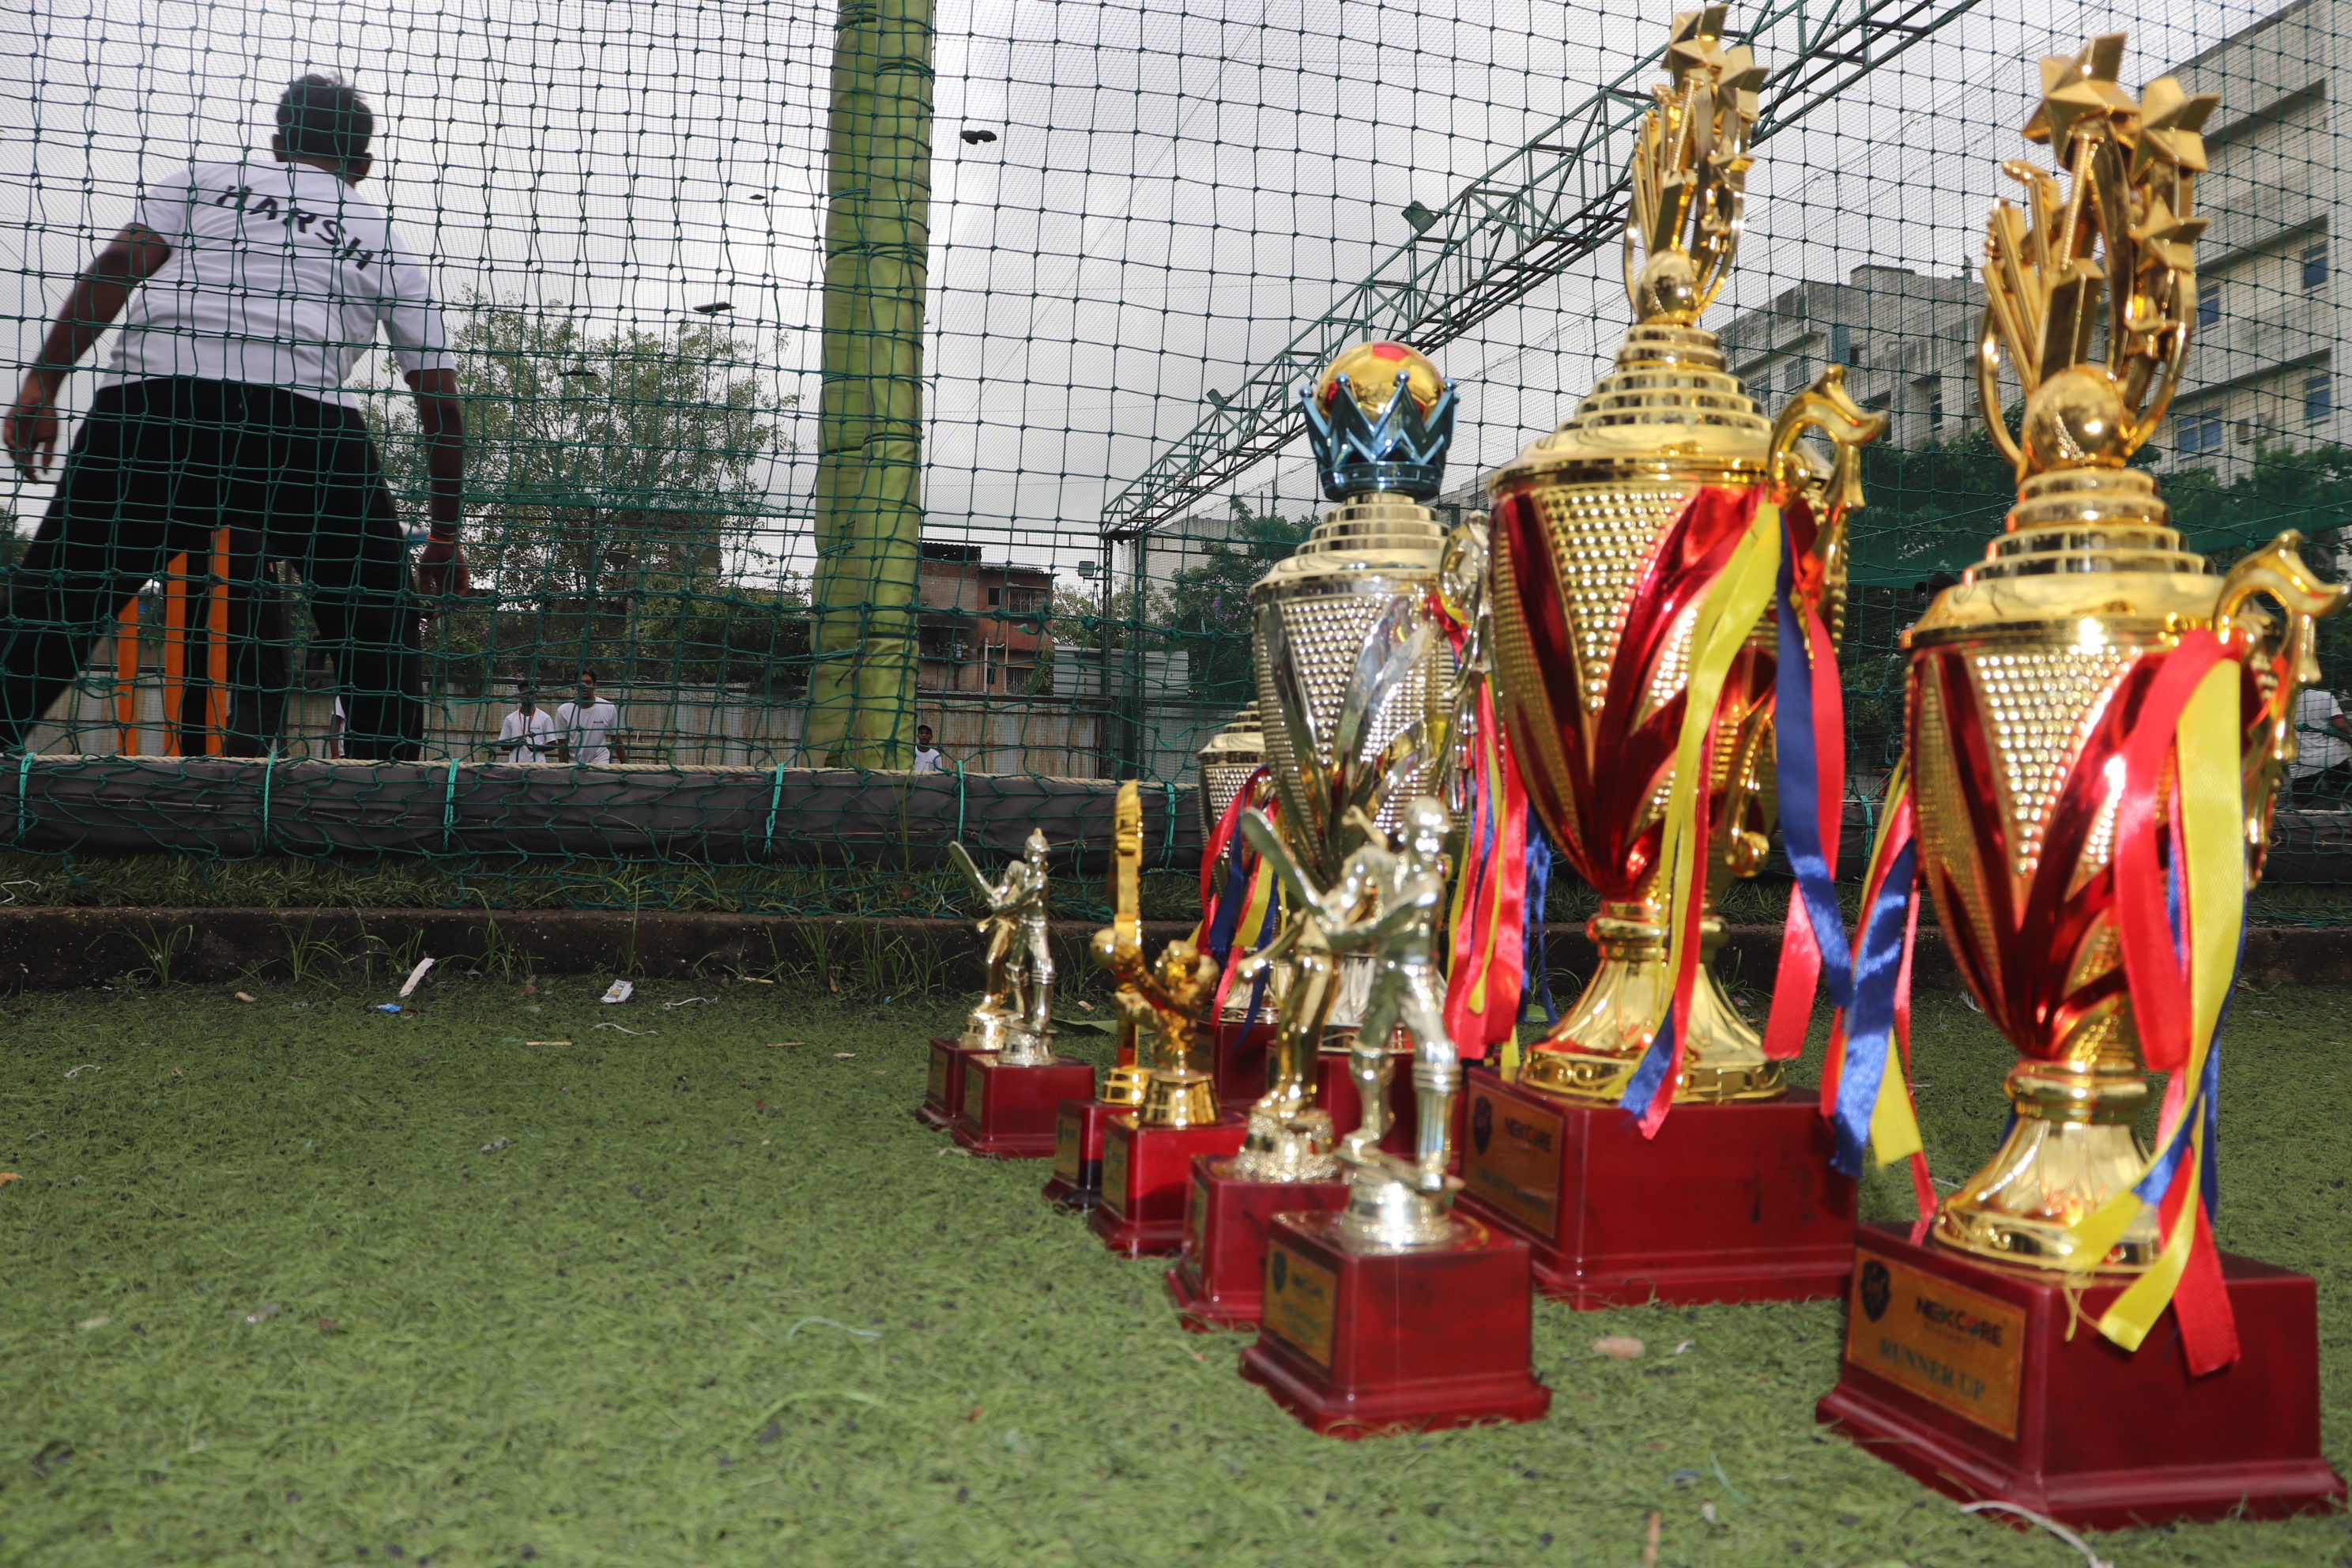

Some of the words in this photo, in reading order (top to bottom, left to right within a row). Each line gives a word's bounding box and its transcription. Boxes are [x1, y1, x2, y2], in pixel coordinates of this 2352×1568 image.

[217, 185, 374, 270] HARSH
[1879, 1337, 1954, 1388] RUNNER
[1959, 1370, 1986, 1400] UP
